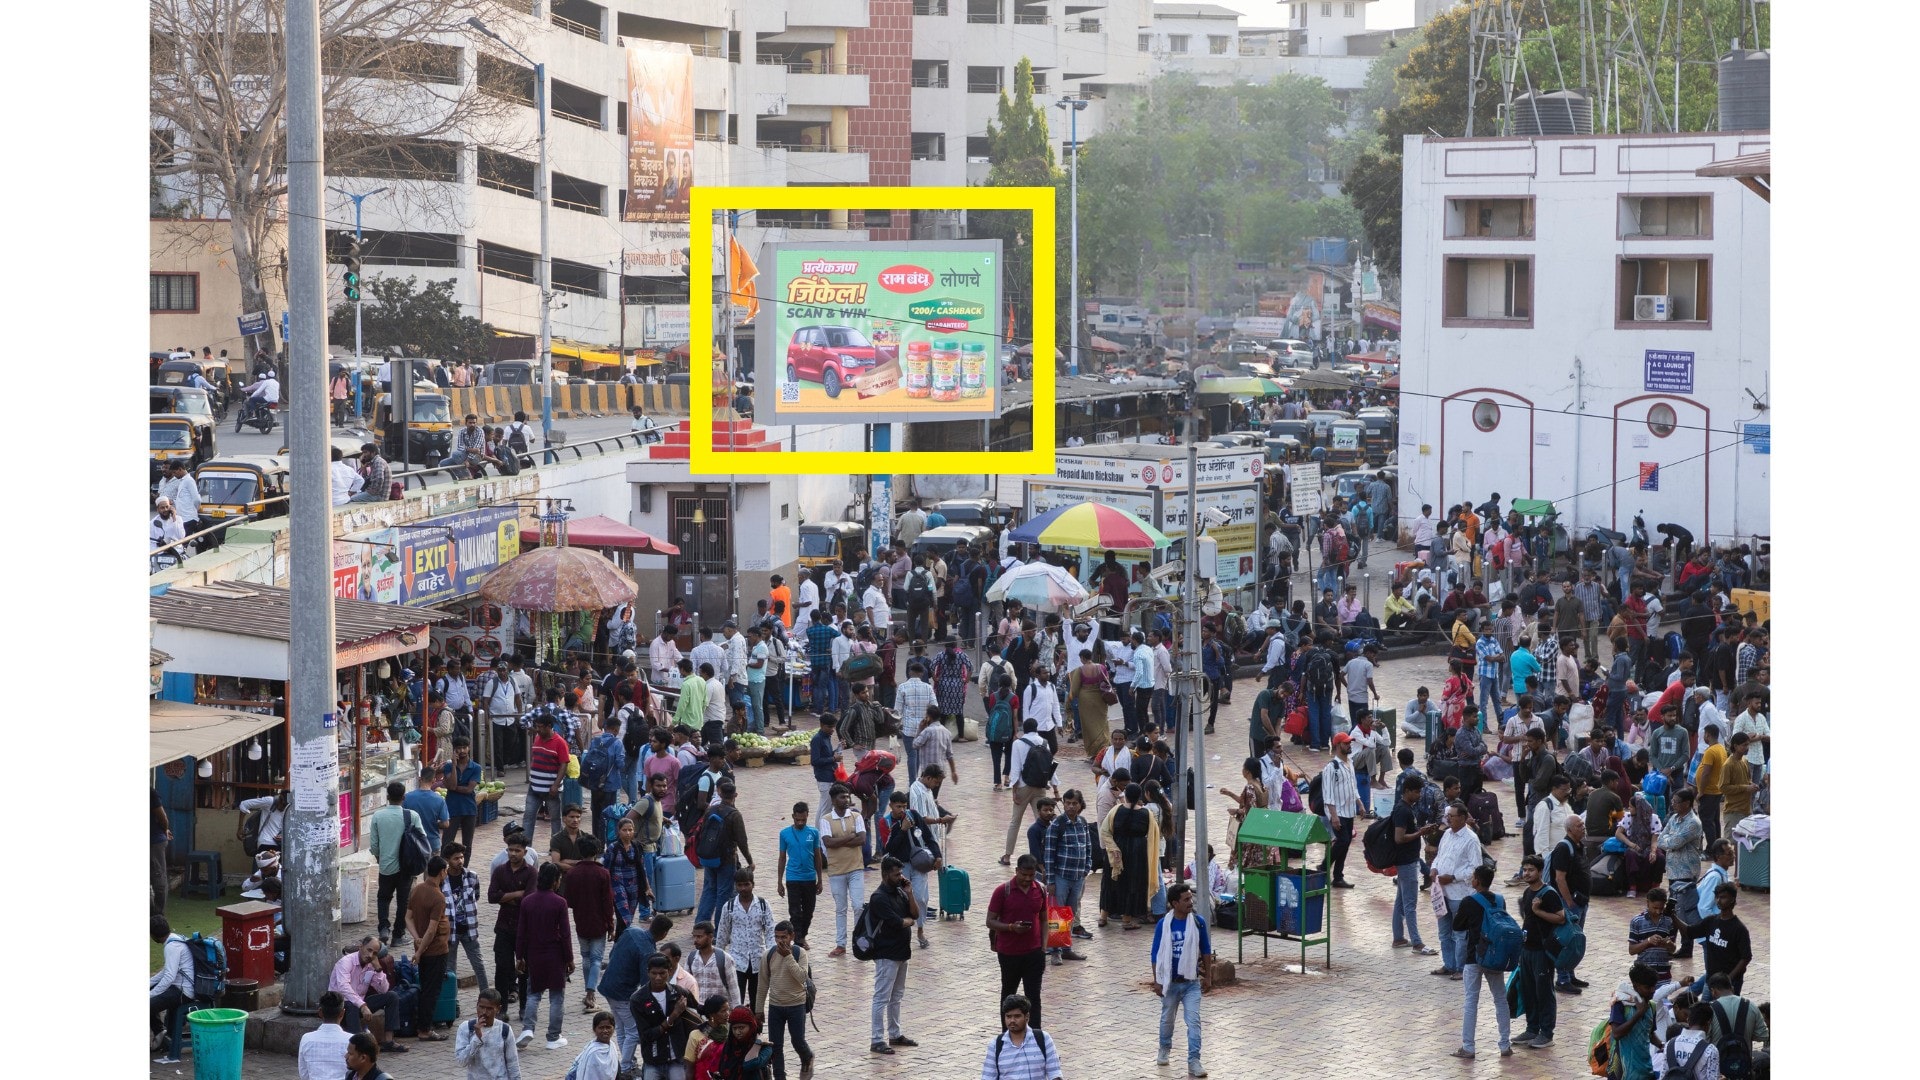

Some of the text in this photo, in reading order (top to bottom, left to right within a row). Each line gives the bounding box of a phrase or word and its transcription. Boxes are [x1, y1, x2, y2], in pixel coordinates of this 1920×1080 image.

[802, 259, 859, 275] प्रत्येकजण
[882, 272, 931, 286] राम बंधू
[940, 268, 981, 287] लोणचे
[787, 275, 868, 304] जिंकेल!
[787, 308, 822, 319] SCAN
[826, 309, 836, 319] &
[937, 307, 983, 315] CASHBACK
[1057, 467, 1124, 483] Prepaid Auto Rickshaw
[1056, 493, 1085, 501] RICKSHAW
[415, 544, 448, 575] EXIT
[417, 572, 446, 592] बाहेर
